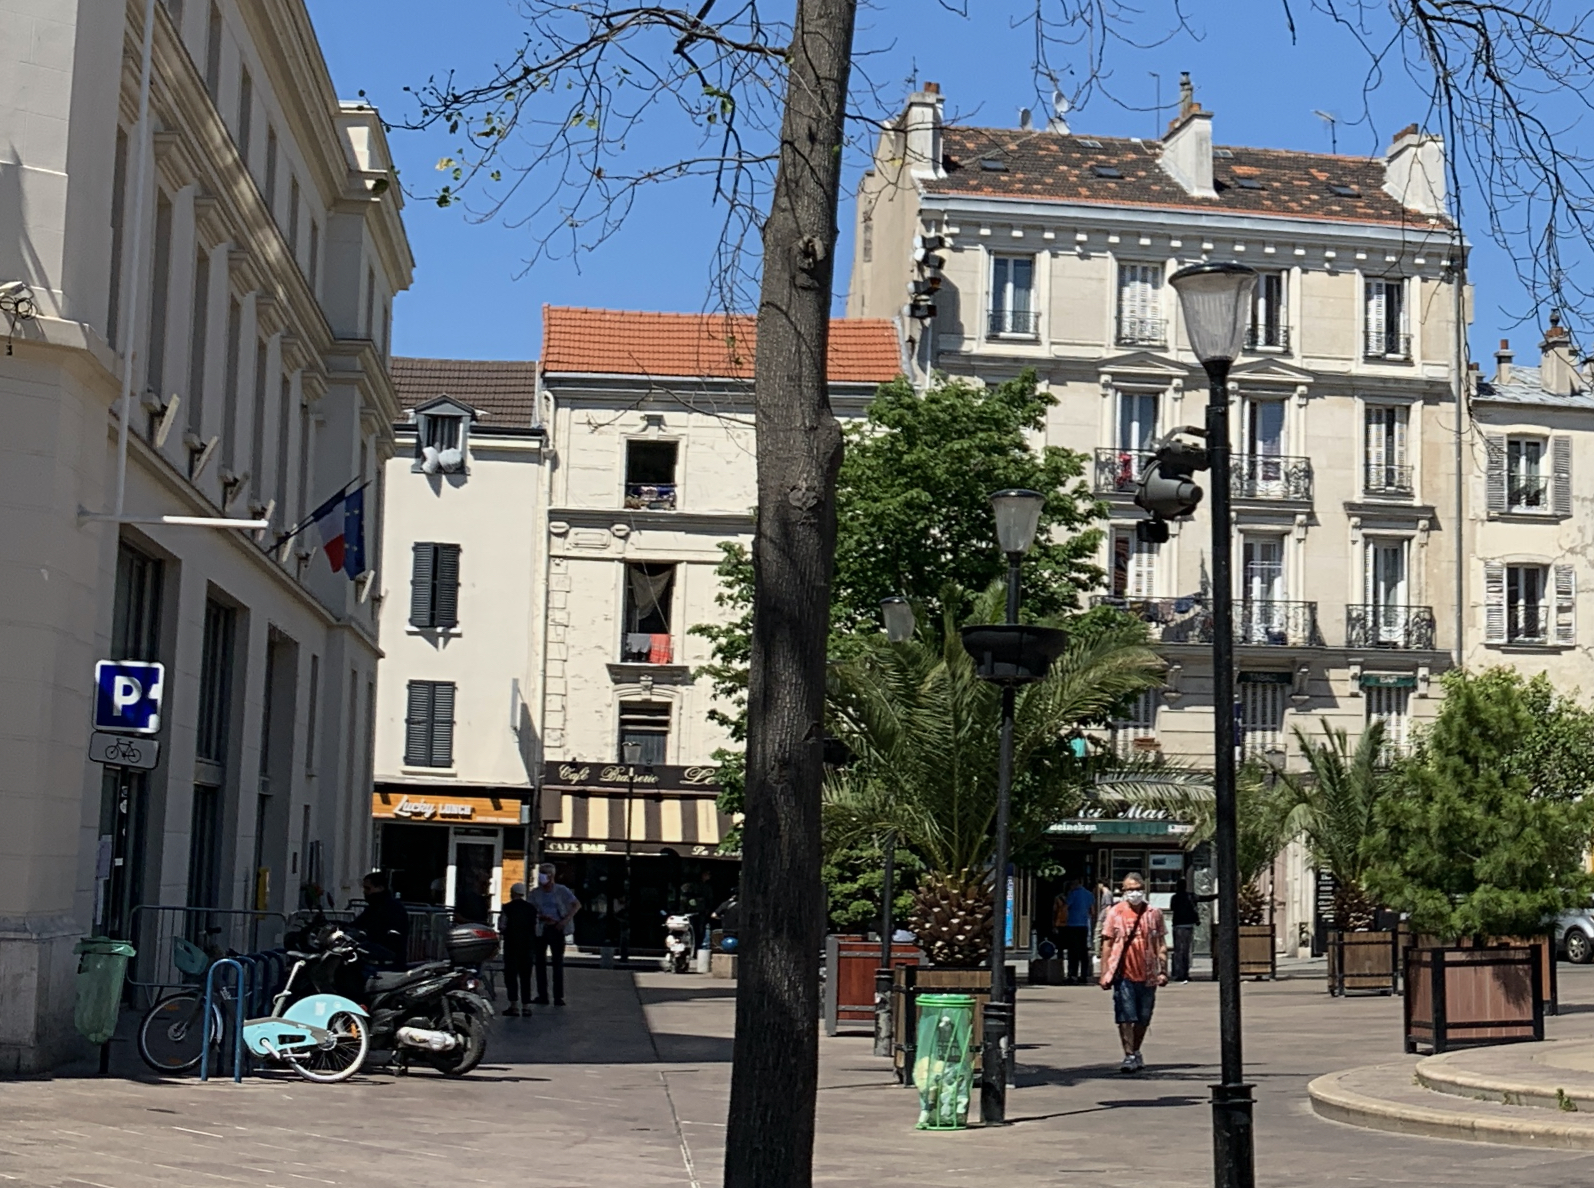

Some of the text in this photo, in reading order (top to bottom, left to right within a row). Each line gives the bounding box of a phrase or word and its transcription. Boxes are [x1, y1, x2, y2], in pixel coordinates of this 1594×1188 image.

[112, 675, 142, 716] P
[558, 764, 591, 784] Café
[393, 795, 472, 818] Lucky LUNCH
